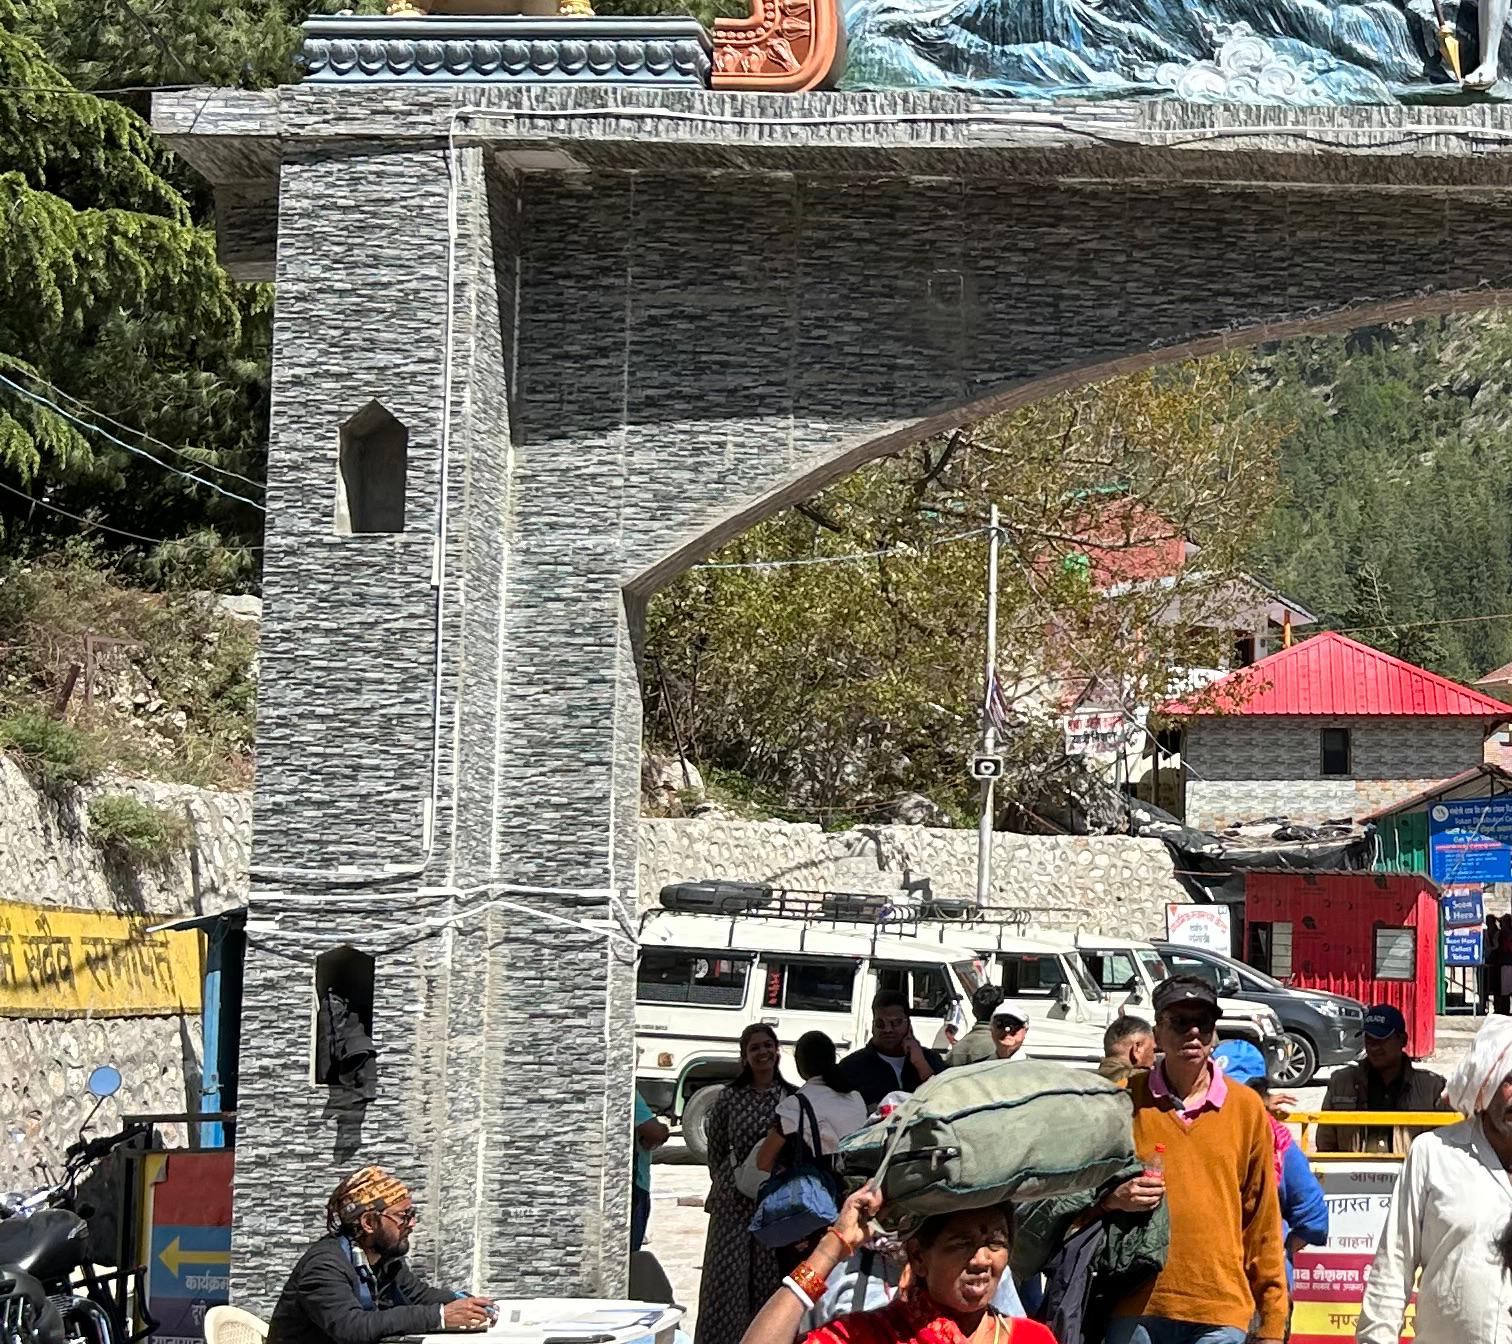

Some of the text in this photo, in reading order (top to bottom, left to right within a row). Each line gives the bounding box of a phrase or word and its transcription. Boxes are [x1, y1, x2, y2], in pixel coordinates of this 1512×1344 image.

[1454, 911, 1473, 919] Here
[1327, 1197, 1371, 1215] ाग्रस्त
[1338, 1233, 1374, 1248] वाहनों
[1313, 1263, 1359, 1282] नैशनल
